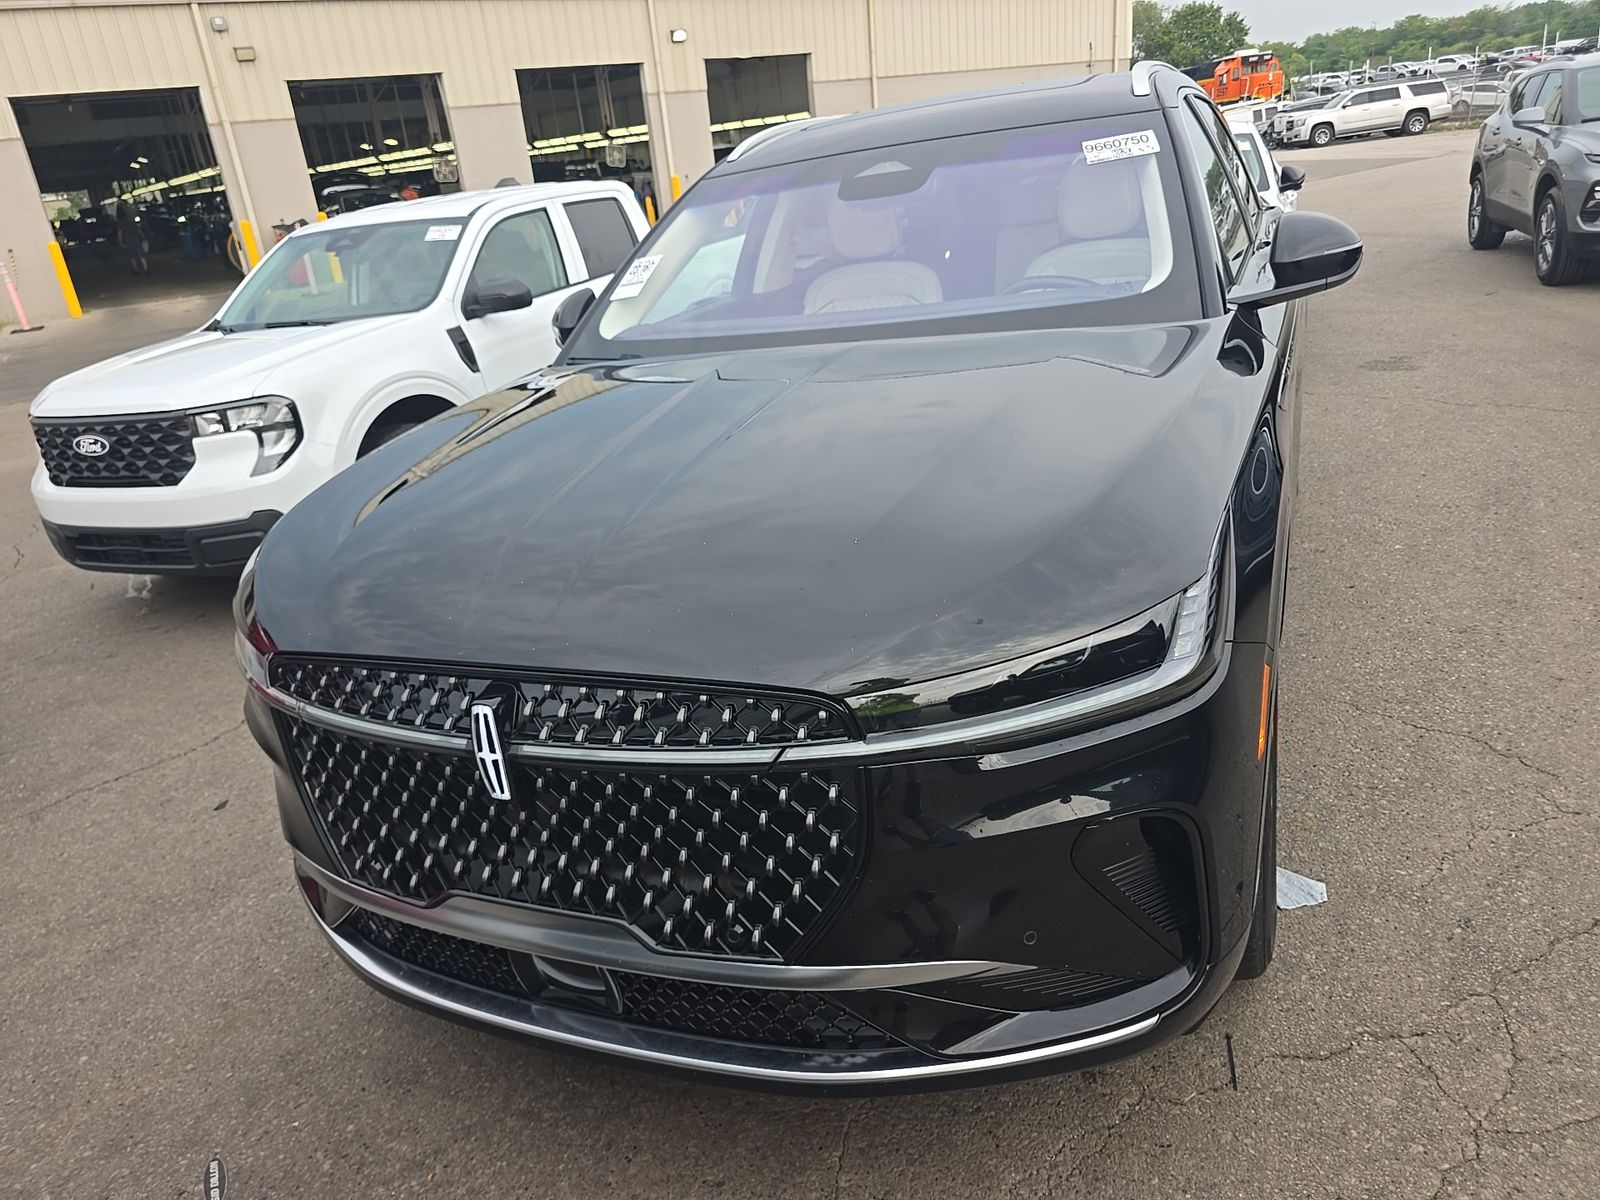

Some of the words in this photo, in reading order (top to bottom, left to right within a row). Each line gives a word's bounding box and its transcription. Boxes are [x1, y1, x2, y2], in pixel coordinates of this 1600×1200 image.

[1085, 134, 1149, 153] 9660750
[78, 437, 104, 454] Ford
[209, 1161, 219, 1188] DILLON
